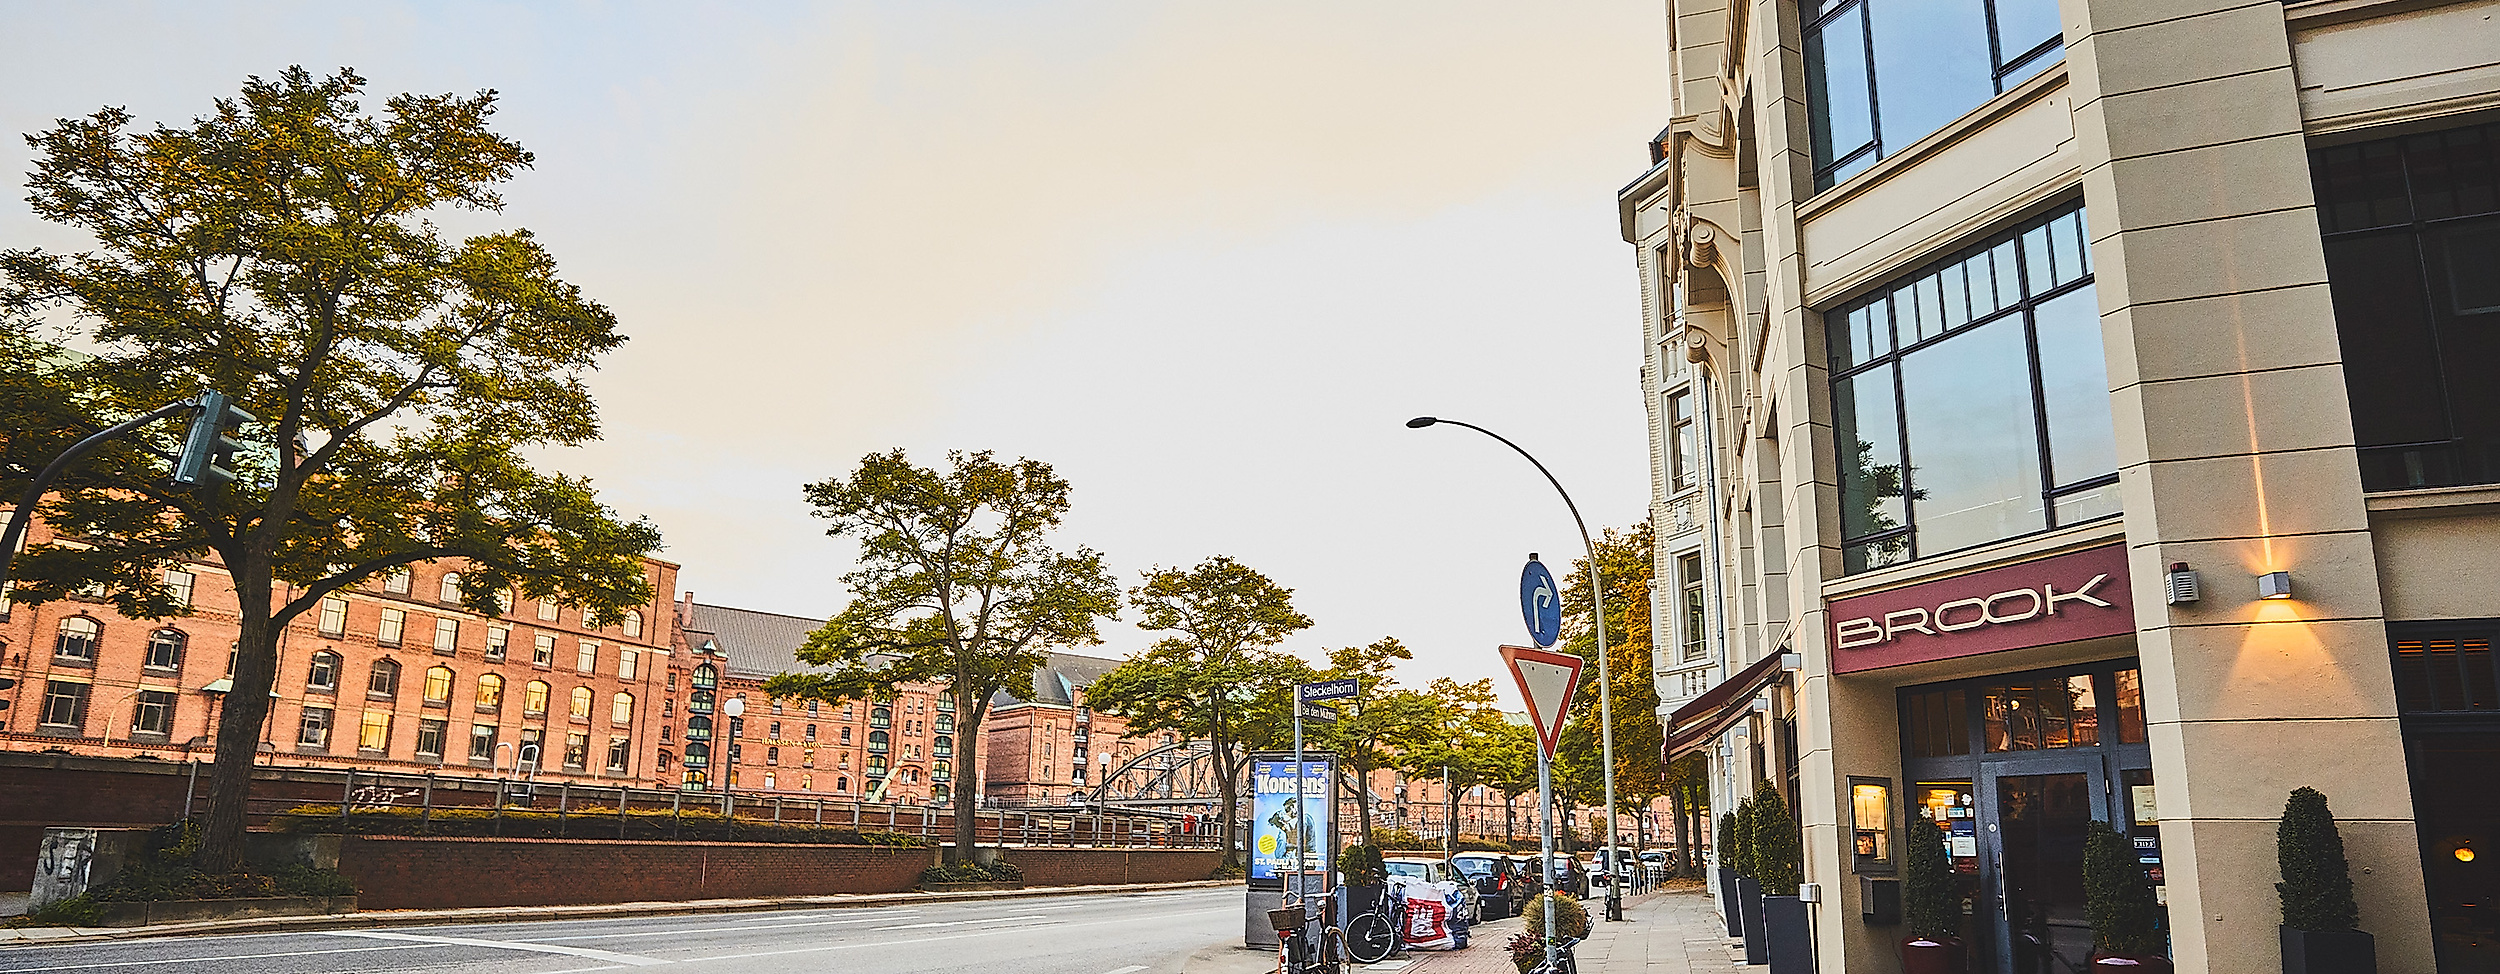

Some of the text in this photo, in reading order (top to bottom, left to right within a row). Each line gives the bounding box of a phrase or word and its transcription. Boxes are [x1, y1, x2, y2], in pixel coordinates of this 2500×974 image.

[1837, 573, 2111, 649] BROOK
[1311, 706, 1319, 718] den
[1257, 774, 1326, 794] Konsens
